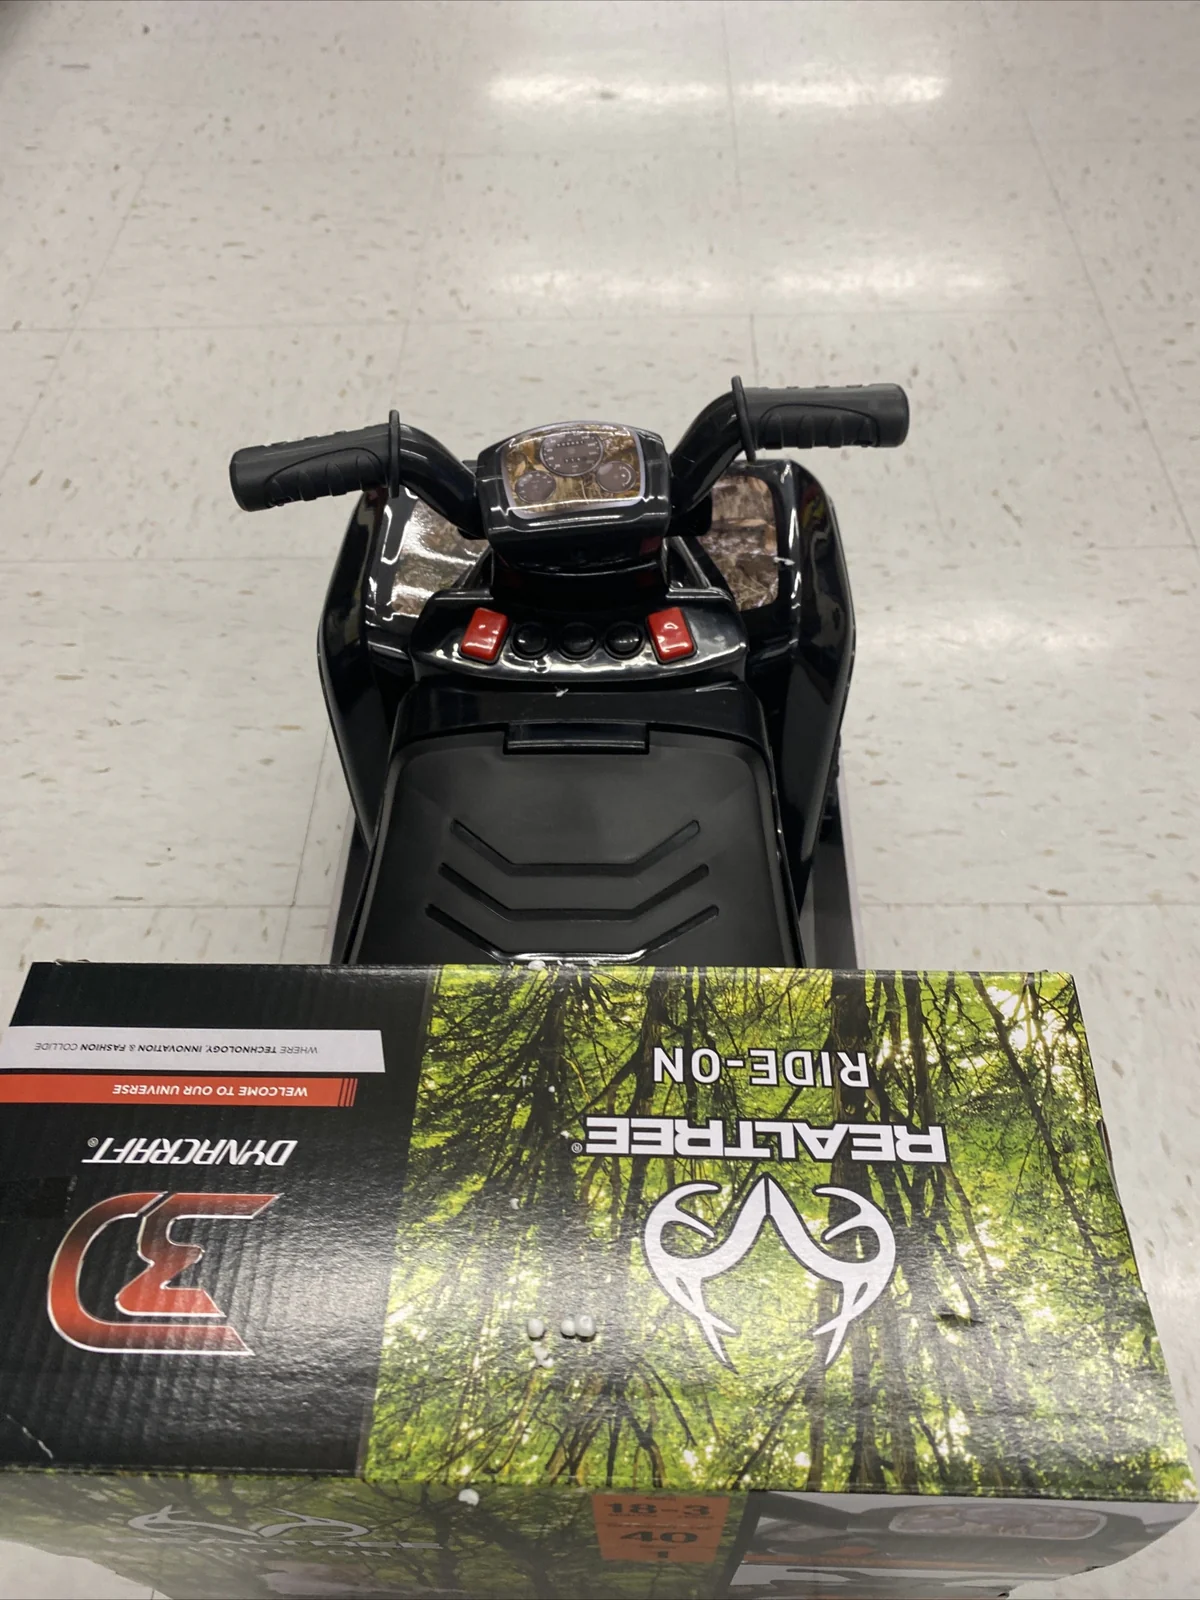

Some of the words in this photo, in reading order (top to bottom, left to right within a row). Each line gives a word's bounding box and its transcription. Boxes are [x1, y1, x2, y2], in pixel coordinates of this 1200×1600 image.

[34, 1042, 78, 1051] COLLIDE
[80, 1043, 126, 1052] FASHION
[138, 1044, 203, 1053] INNOVATION
[279, 1046, 318, 1054] WHERE
[653, 1046, 870, 1088] RIDE-ON
[112, 1084, 180, 1095] UNIVERSE
[183, 1085, 213, 1096] OUR
[216, 1086, 234, 1097] TO
[238, 1086, 308, 1097] WELCOME
[620, 1531, 698, 1544] 40
